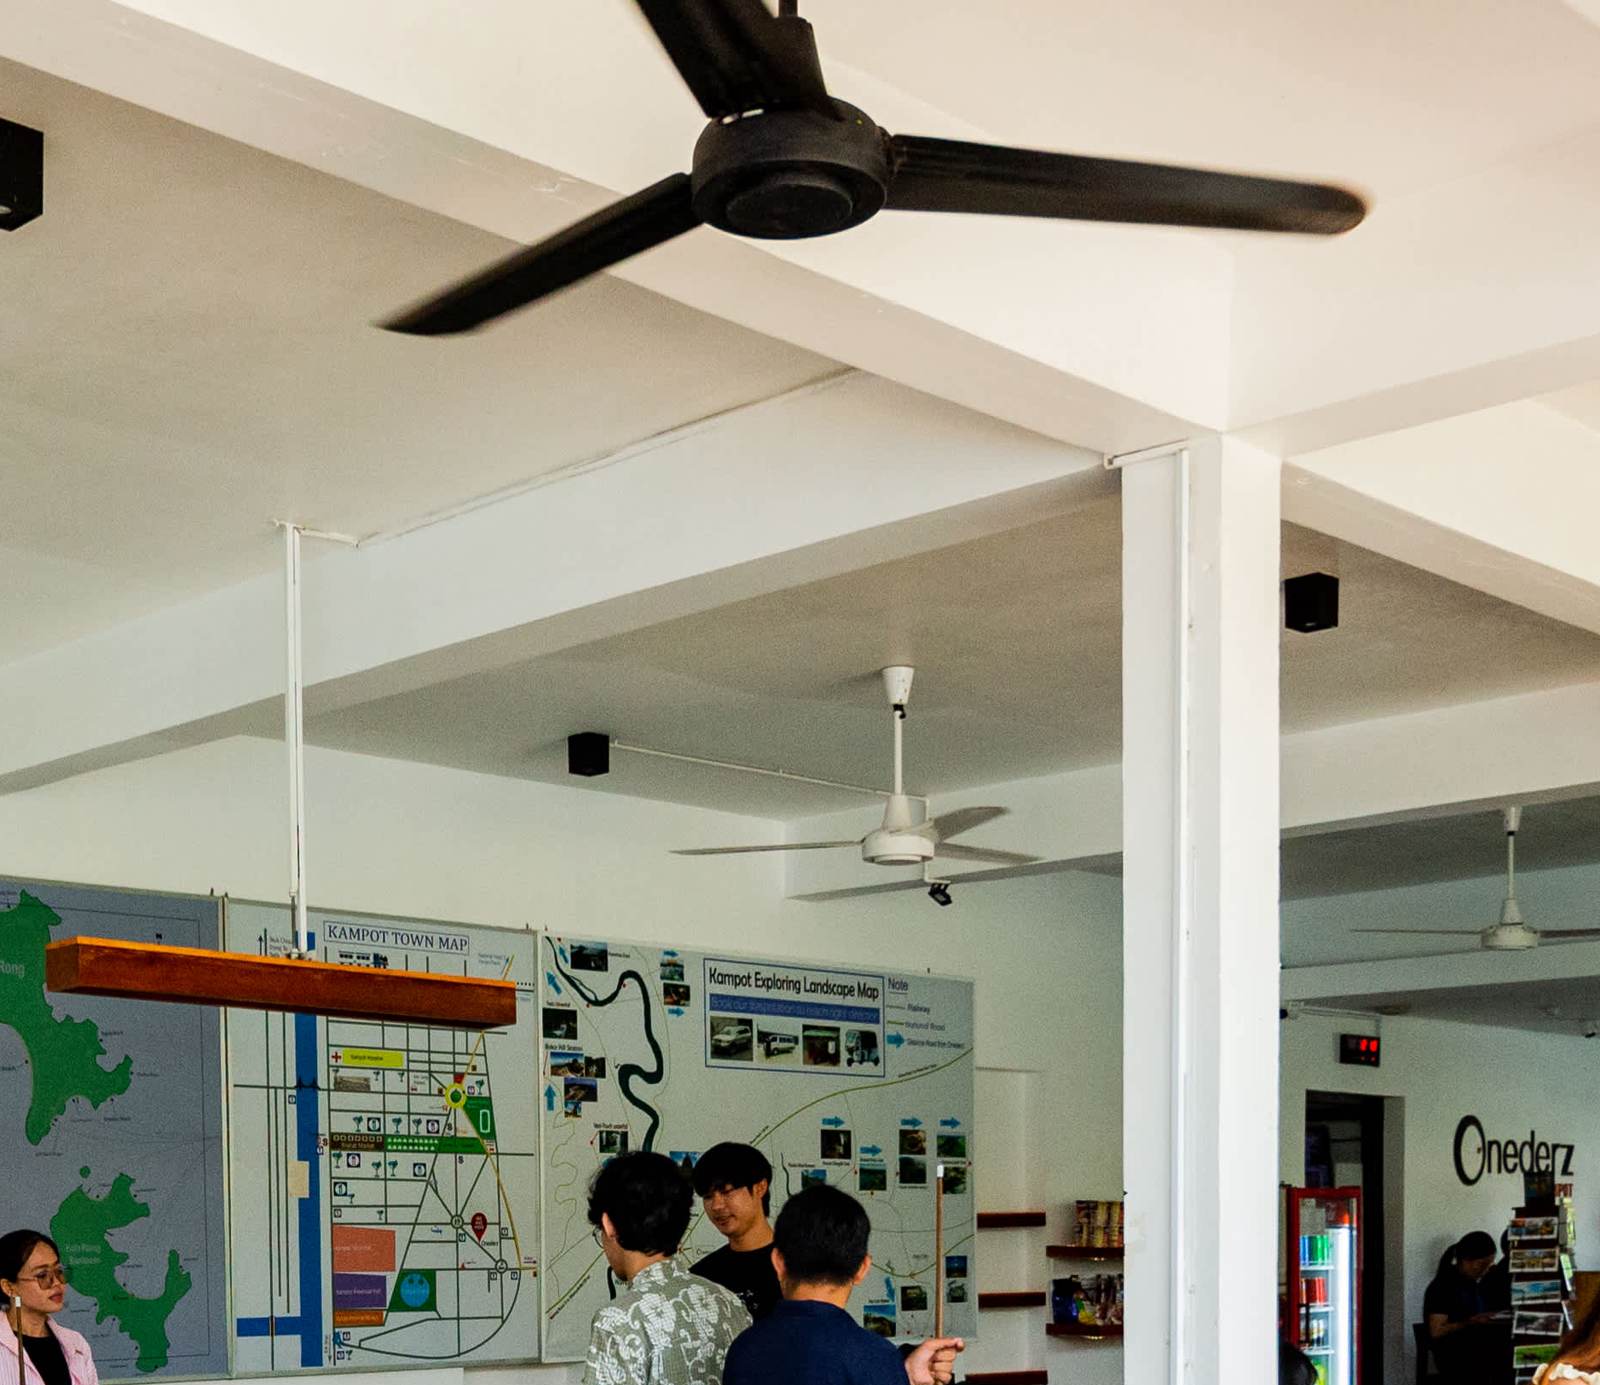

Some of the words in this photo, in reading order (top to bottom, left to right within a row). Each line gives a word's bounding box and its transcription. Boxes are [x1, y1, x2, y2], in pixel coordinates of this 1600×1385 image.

[328, 925, 389, 943] KAMPOT
[391, 931, 434, 948] TOWN
[439, 937, 468, 951] MAP
[709, 967, 752, 988] Kampot
[754, 972, 801, 994] Exploring
[803, 976, 855, 998] Landscape
[857, 981, 879, 1000] Map
[888, 977, 908, 991] Note
[1453, 1114, 1575, 1186] Onederz
